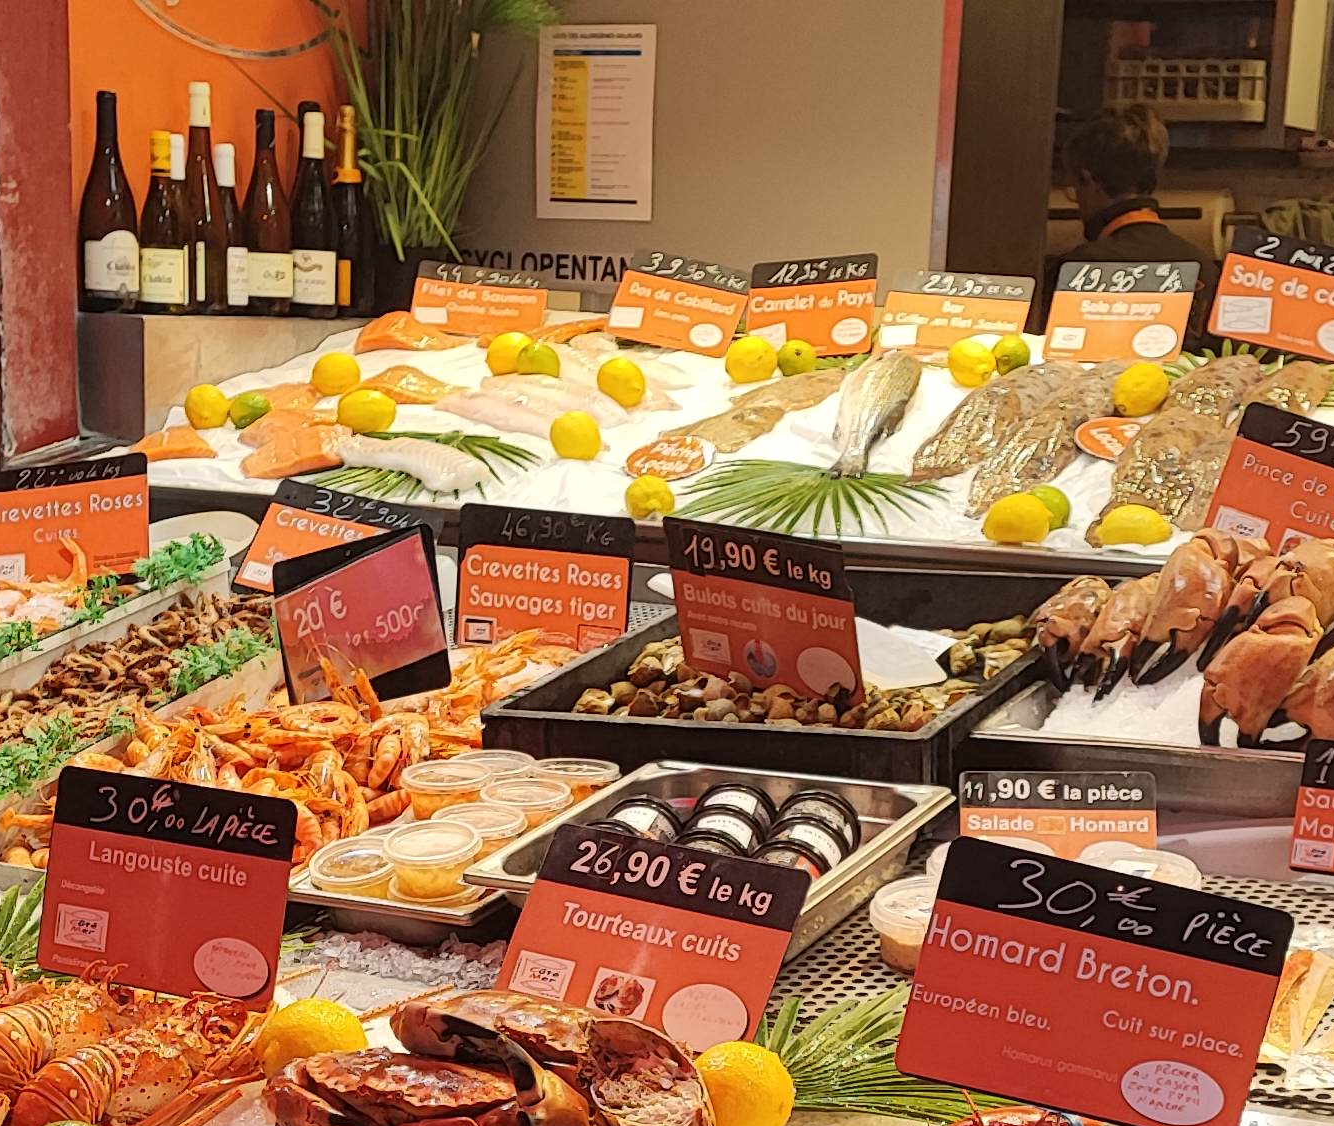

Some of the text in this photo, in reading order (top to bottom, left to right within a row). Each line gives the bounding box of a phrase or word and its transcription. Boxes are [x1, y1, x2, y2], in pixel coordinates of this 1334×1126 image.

[482, 289, 538, 305] Saumon
[629, 281, 736, 315] Dos de Cabillaud
[1229, 265, 1274, 291] Sole
[1280, 276, 1309, 297] de
[750, 290, 873, 313] Carrelet Pays
[942, 300, 965, 313] Bar
[1243, 453, 1296, 486] Pince
[1303, 475, 1328, 498] de
[89, 490, 144, 513] Roses
[467, 555, 623, 592] Crevettes Roses
[809, 562, 834, 592] kg
[468, 585, 616, 623] Sauvages tiger
[683, 583, 740, 614] Bulots
[743, 591, 781, 619] cuits
[786, 602, 807, 623] du
[811, 607, 848, 634] jour
[1037, 779, 1143, 804] € pièce
[967, 815, 1149, 833] Salade Homard
[89, 841, 248, 887] Langouste cuite
[570, 840, 773, 916] 26,90 kg
[562, 901, 742, 962] Tourteaux cuits
[927, 912, 1199, 1006] Homard Breton.
[912, 984, 1051, 1031] Européen bleu.
[1102, 1010, 1244, 1058] Cuit sur place.
